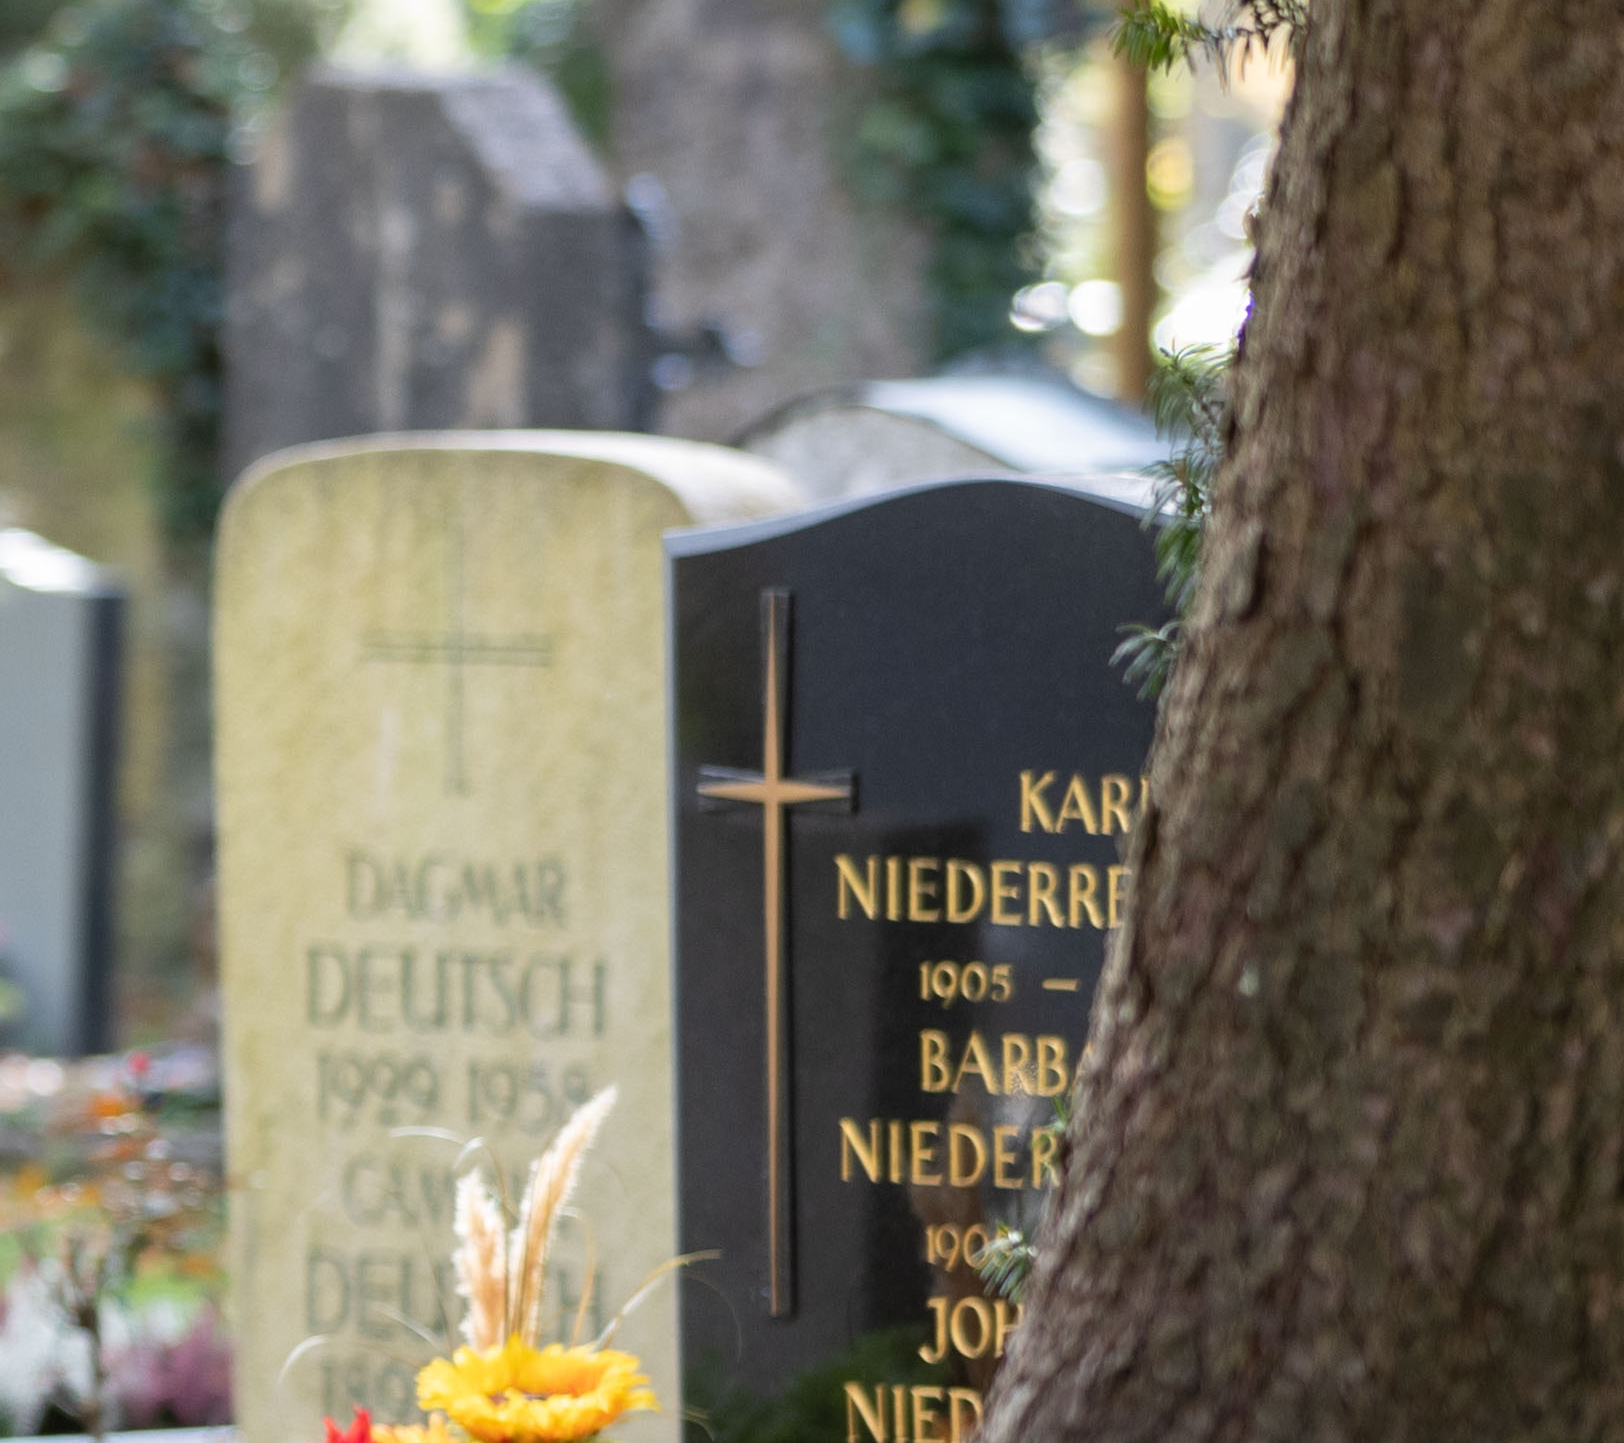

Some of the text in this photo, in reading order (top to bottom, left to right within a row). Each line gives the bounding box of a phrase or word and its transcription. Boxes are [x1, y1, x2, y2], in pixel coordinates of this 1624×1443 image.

[345, 853, 569, 929] DAGMAR
[305, 943, 606, 1040] DEUTSCH
[918, 960, 1013, 1009] 1905
[920, 1027, 1072, 1097] BARB
[925, 1222, 998, 1273] 190
